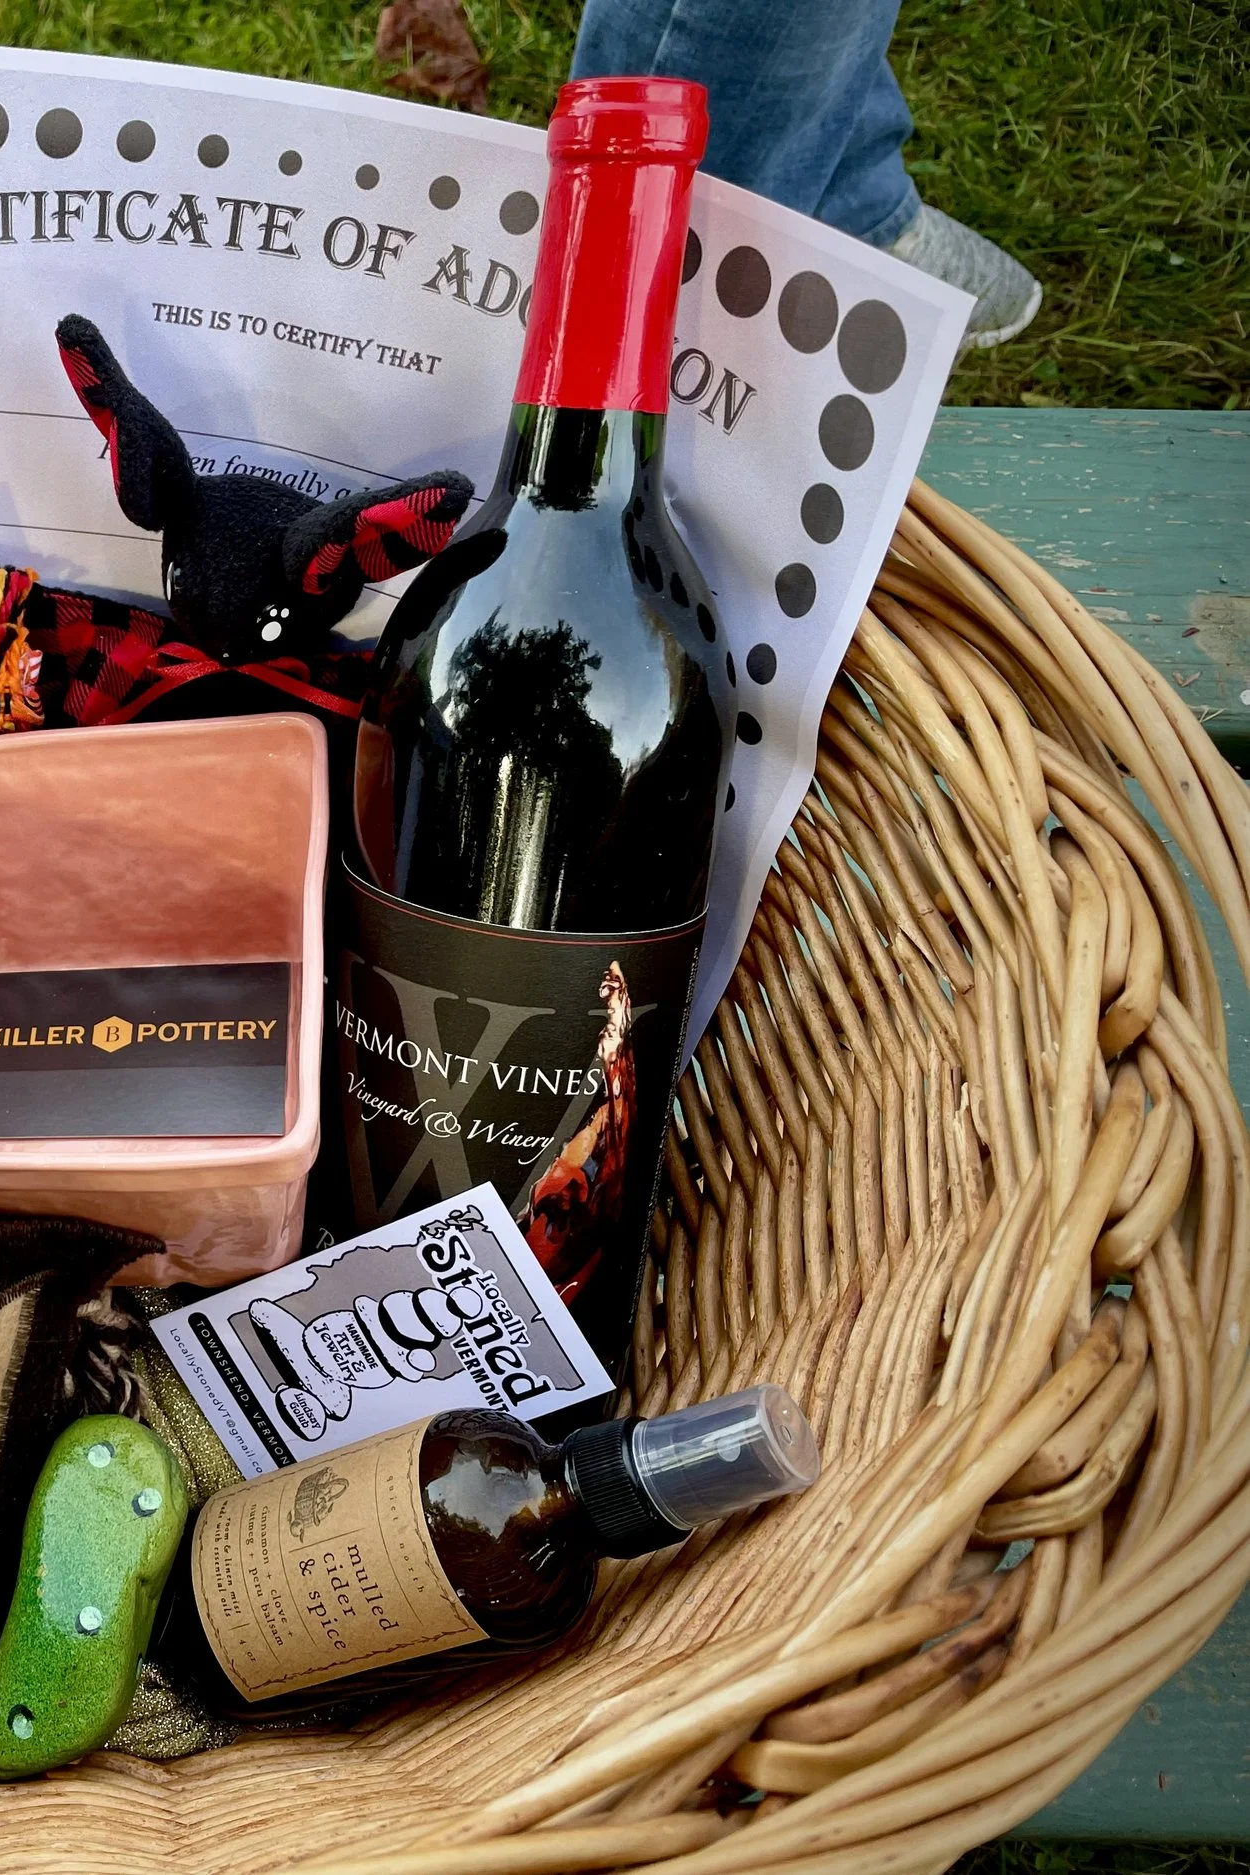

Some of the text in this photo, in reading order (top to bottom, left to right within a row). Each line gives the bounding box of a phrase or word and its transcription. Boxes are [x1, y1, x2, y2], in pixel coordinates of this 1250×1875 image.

[322, 215, 417, 280] OF
[152, 302, 443, 375] THIS IS TO CERTIFY THAT
[223, 454, 330, 500] formally
[104, 1025, 121, 1043] B
[136, 1018, 278, 1043] POTTERY
[334, 1000, 479, 1085] VERMONT
[346, 1072, 555, 1165] Vineyard & Winery
[420, 1233, 553, 1410] Stoned
[476, 1272, 532, 1349] Locally
[313, 1322, 357, 1385] Jewelry
[335, 1331, 366, 1374] Art &
[344, 1323, 379, 1370] HANDMADE
[453, 1336, 510, 1414] VERMONT
[169, 1327, 265, 1476] LocallyStonedVT@gmail.co
[289, 1399, 311, 1430] Golub
[293, 1391, 323, 1431] Lindsay
[252, 1411, 292, 1467] VERMON
[245, 1503, 258, 1546] nutmeg
[386, 1475, 425, 1594] quiet north
[213, 1547, 227, 1593] essential
[220, 1597, 232, 1618] oils
[224, 1557, 233, 1587] linen
[230, 1591, 242, 1615] mist
[248, 1567, 264, 1599] peru
[260, 1505, 270, 1566] cinnamon
[270, 1589, 288, 1625] clove
[323, 1552, 358, 1619] cider
[347, 1543, 400, 1633] mulled
[260, 1603, 285, 1648] balsam
[299, 1558, 348, 1651] & spice
